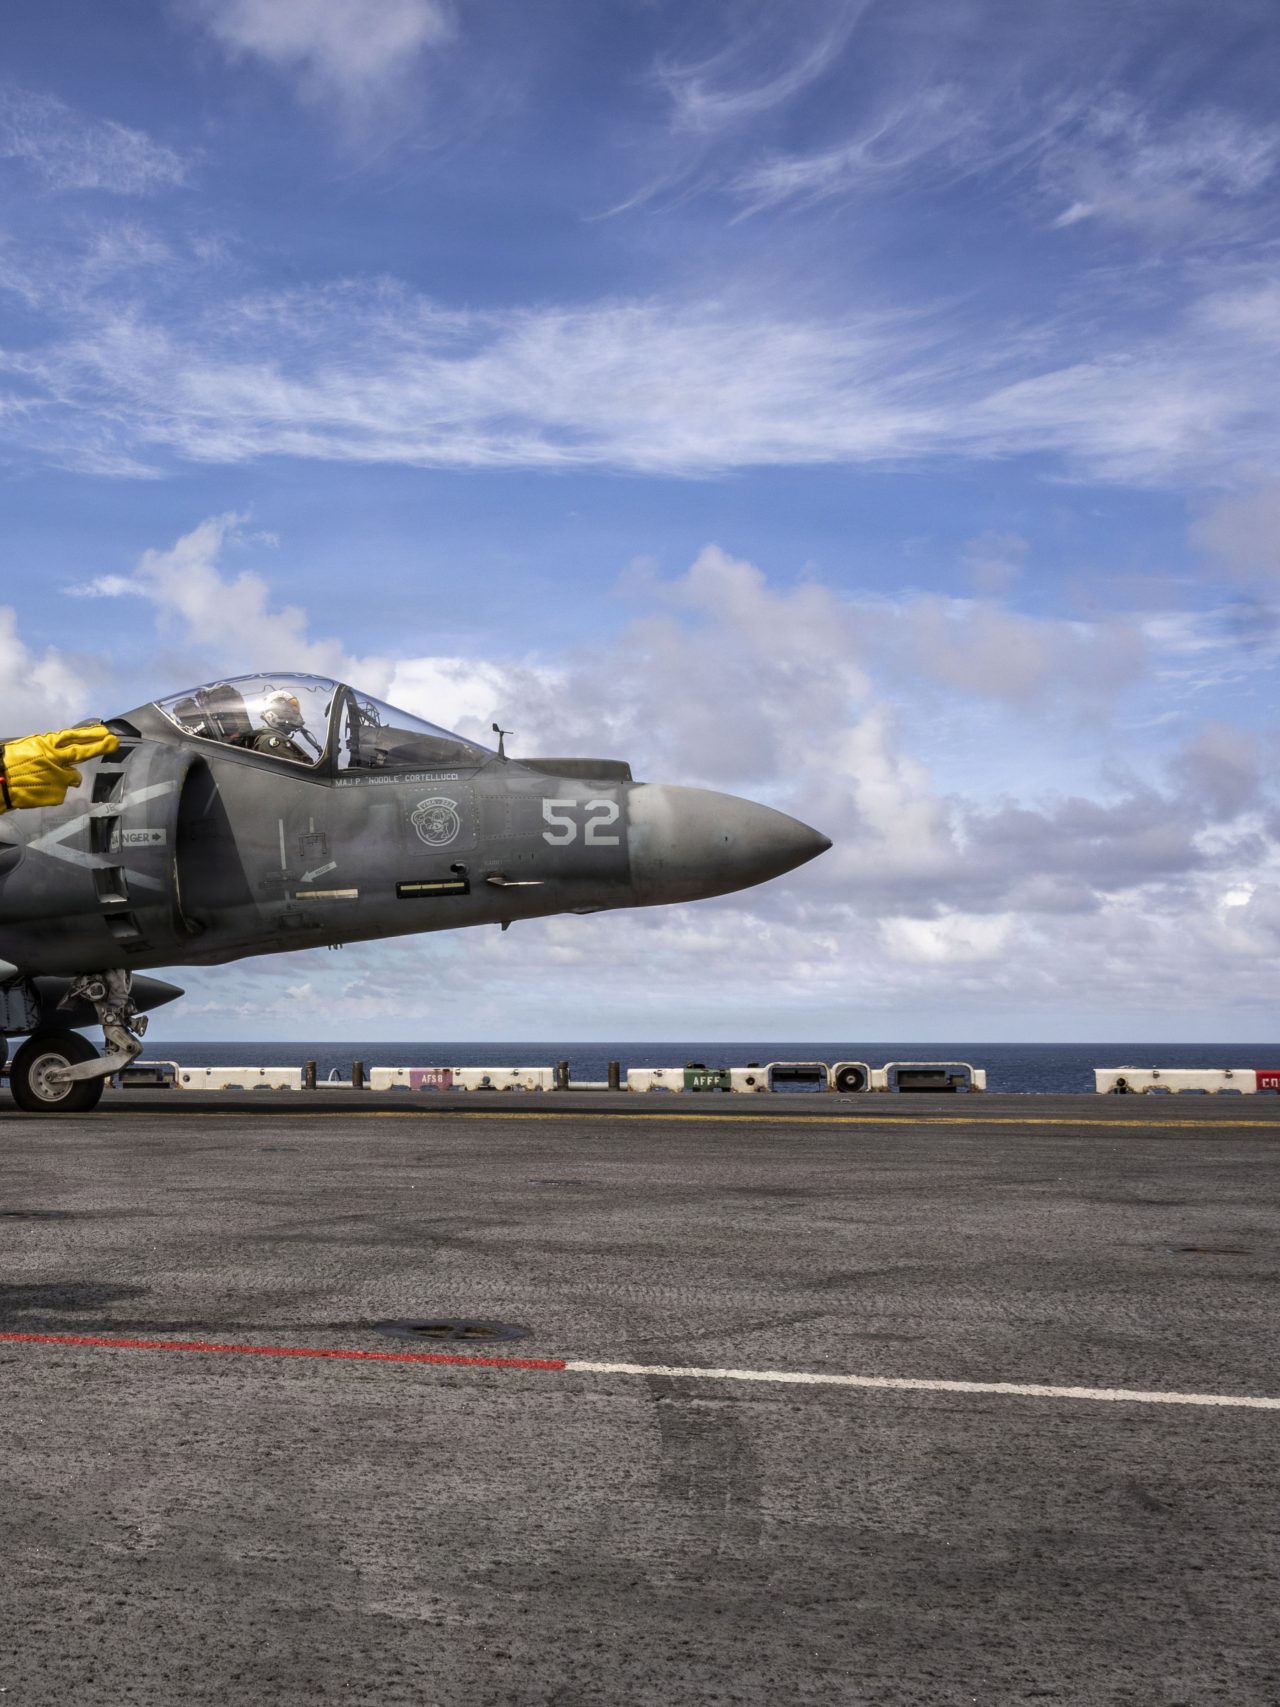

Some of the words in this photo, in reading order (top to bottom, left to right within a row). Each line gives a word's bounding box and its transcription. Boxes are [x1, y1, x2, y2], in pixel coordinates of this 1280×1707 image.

[335, 778, 353, 787] MAJ
[404, 773, 459, 782] CORTELLUCCI
[542, 799, 620, 846] 52
[421, 1074, 437, 1083] AFS
[693, 1076, 721, 1086] AFFF
[1262, 1078, 1280, 1088] CO
